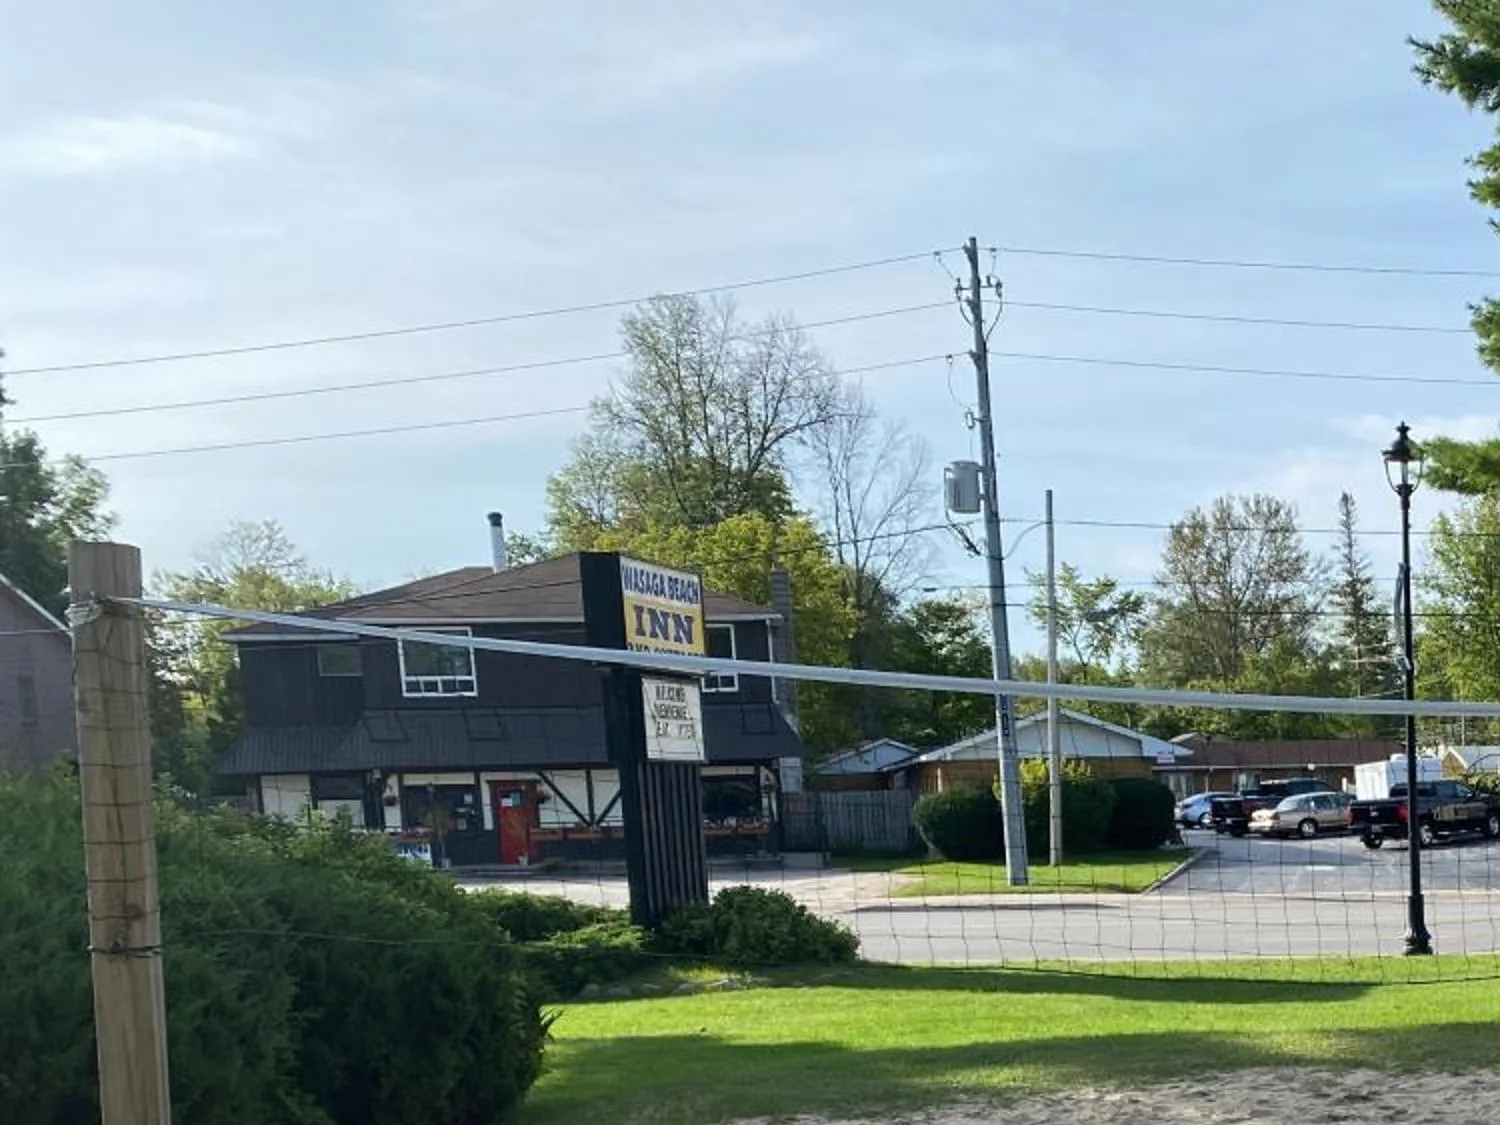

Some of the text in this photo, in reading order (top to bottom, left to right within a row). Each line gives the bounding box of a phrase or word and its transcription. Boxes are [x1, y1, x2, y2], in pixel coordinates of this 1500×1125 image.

[621, 564, 699, 605] WASAGA BEACH
[634, 604, 694, 645] INN
